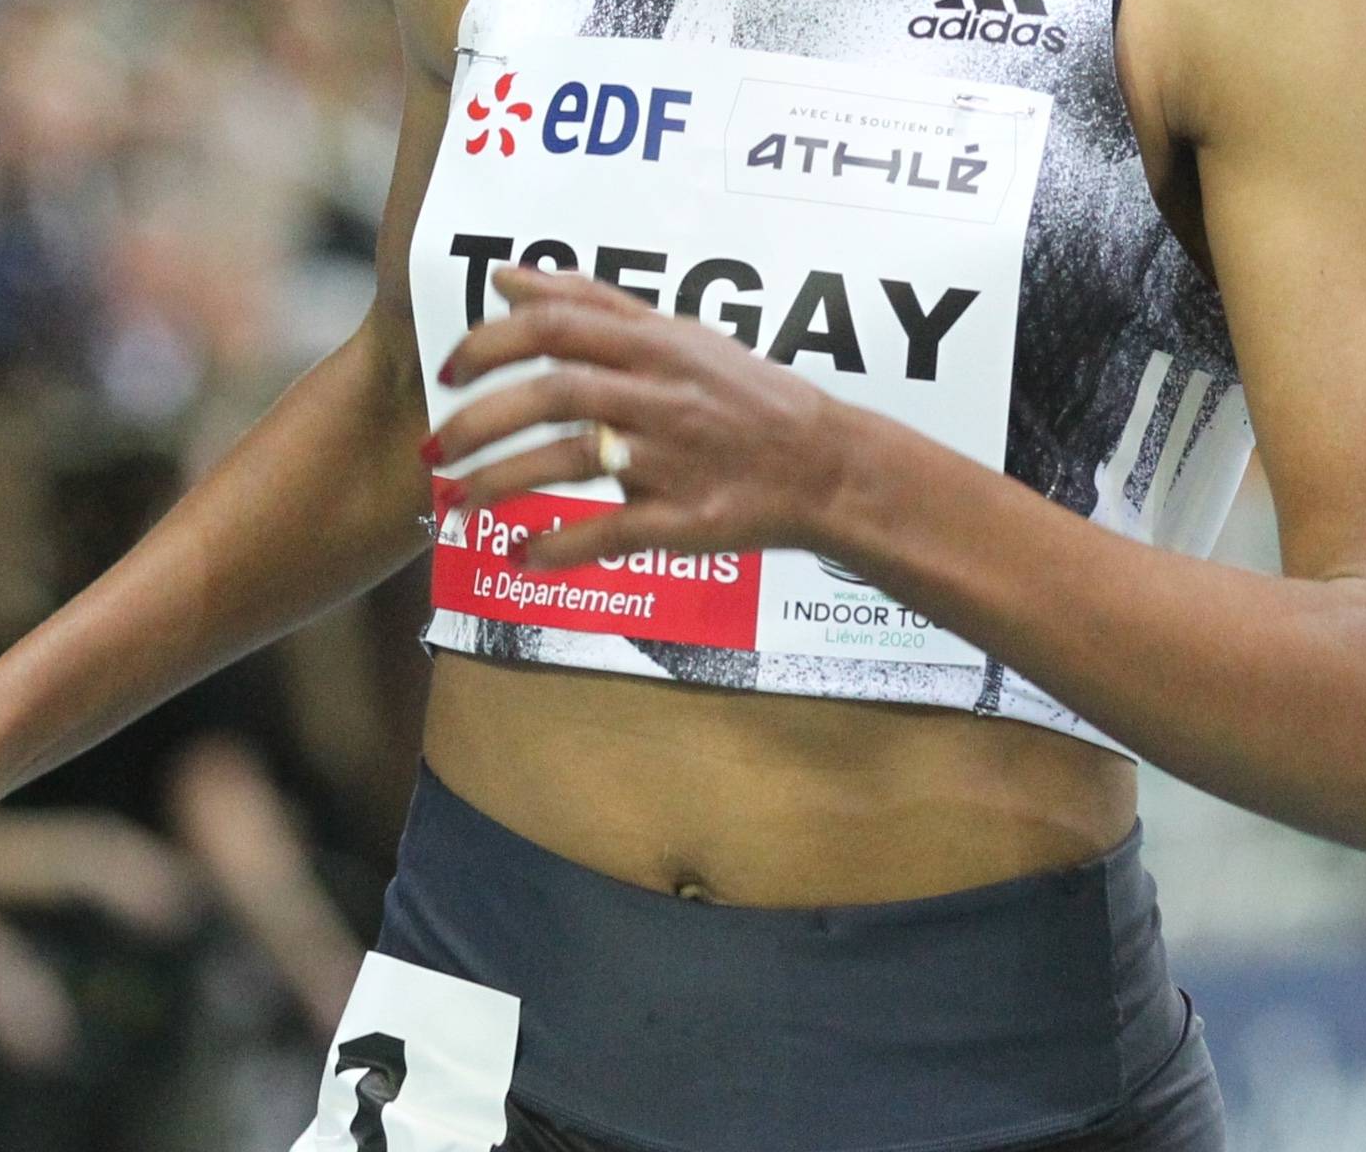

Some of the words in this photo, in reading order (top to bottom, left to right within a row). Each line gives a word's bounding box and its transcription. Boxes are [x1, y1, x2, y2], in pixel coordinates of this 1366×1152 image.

[908, 10, 1067, 54] adidas
[789, 106, 829, 120] AVEC
[835, 113, 853, 125] LE
[859, 115, 928, 134] SOUTIEN
[934, 125, 956, 137] DE
[747, 133, 988, 194] ATHLÉ
[450, 233, 981, 382] TEGAY
[474, 567, 493, 597] Le
[495, 572, 655, 618] Département
[833, 592, 869, 602] WORLD
[783, 600, 890, 626] INDOOR
[825, 628, 874, 645] Liévin
[878, 630, 926, 649] 2020
